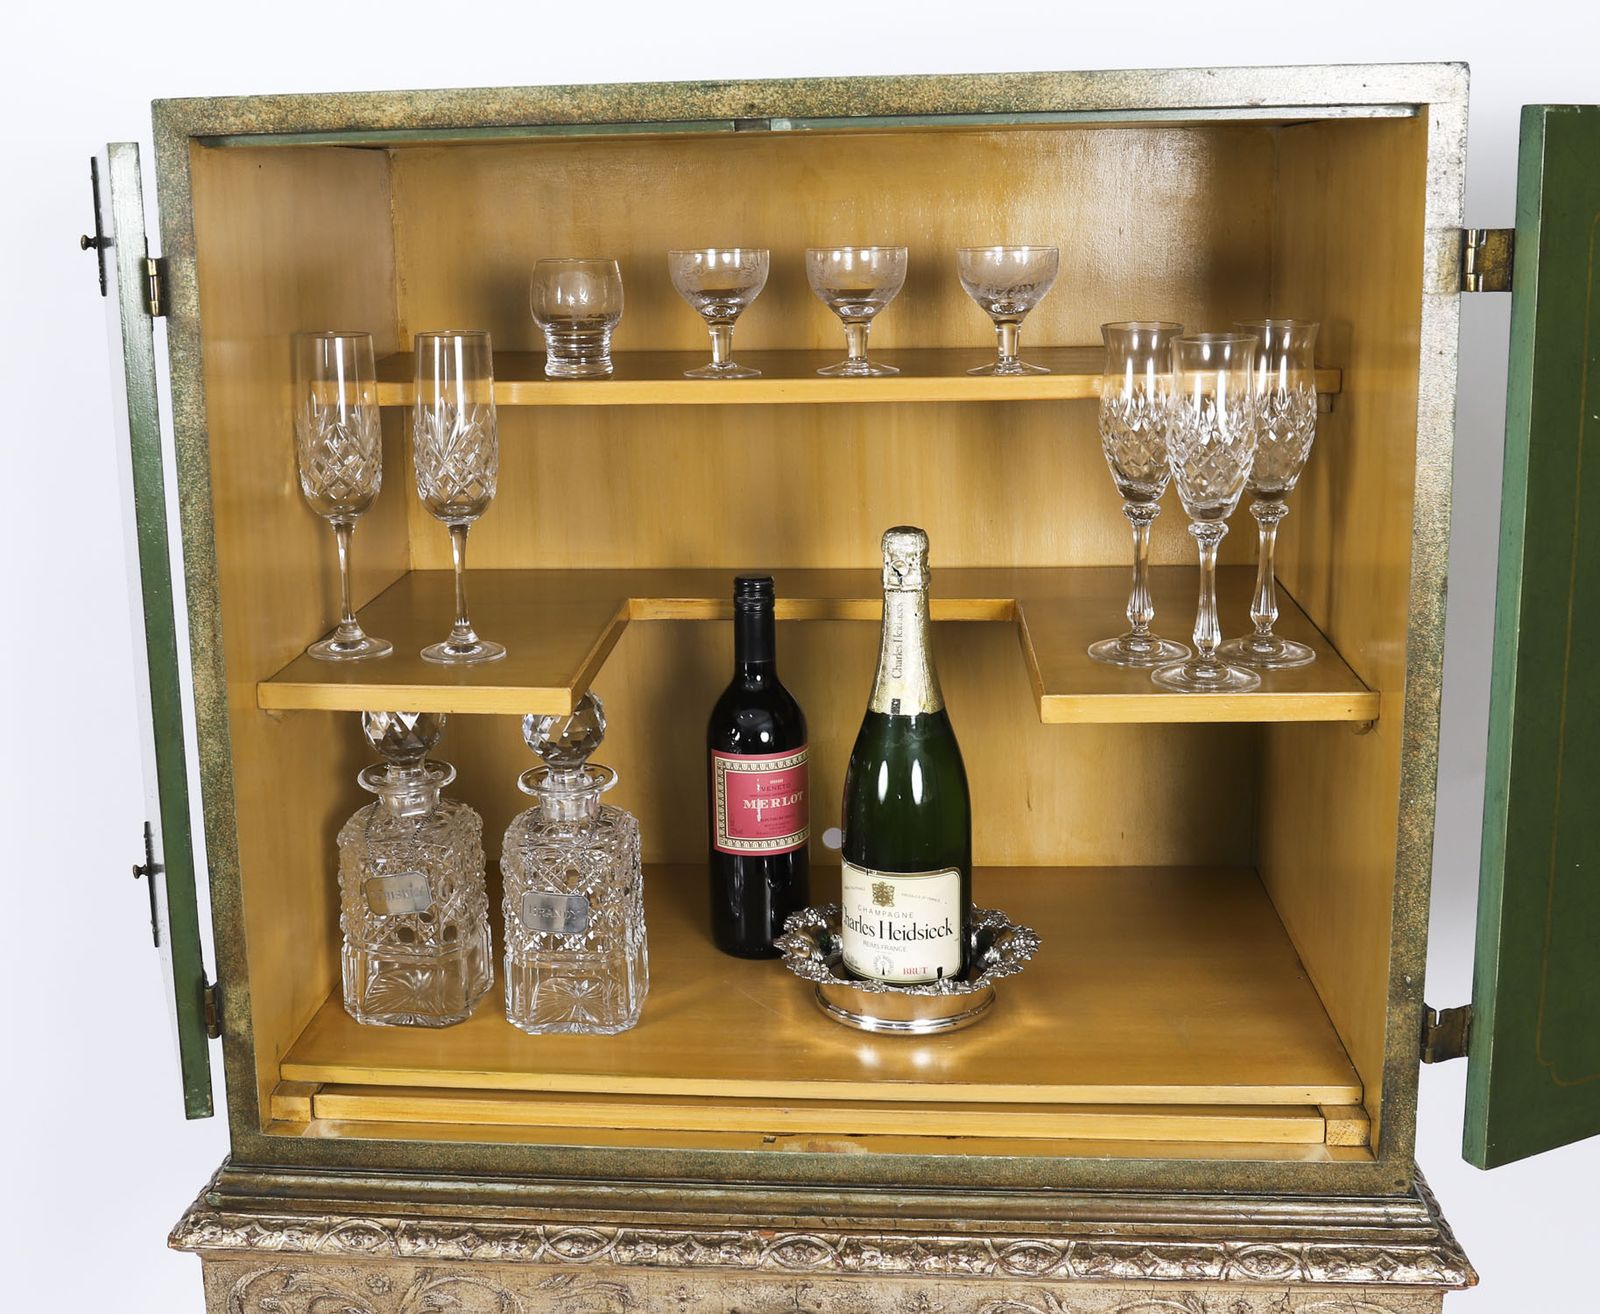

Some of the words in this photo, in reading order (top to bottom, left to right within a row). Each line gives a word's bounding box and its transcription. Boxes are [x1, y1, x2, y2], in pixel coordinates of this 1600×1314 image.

[892, 646, 903, 679] Charles
[761, 783, 791, 792] VENETO
[743, 791, 804, 809] MERLOT
[857, 904, 914, 919] CHAMPAGNE
[879, 917, 953, 942] Heidsieck
[902, 966, 929, 976] BRUT
